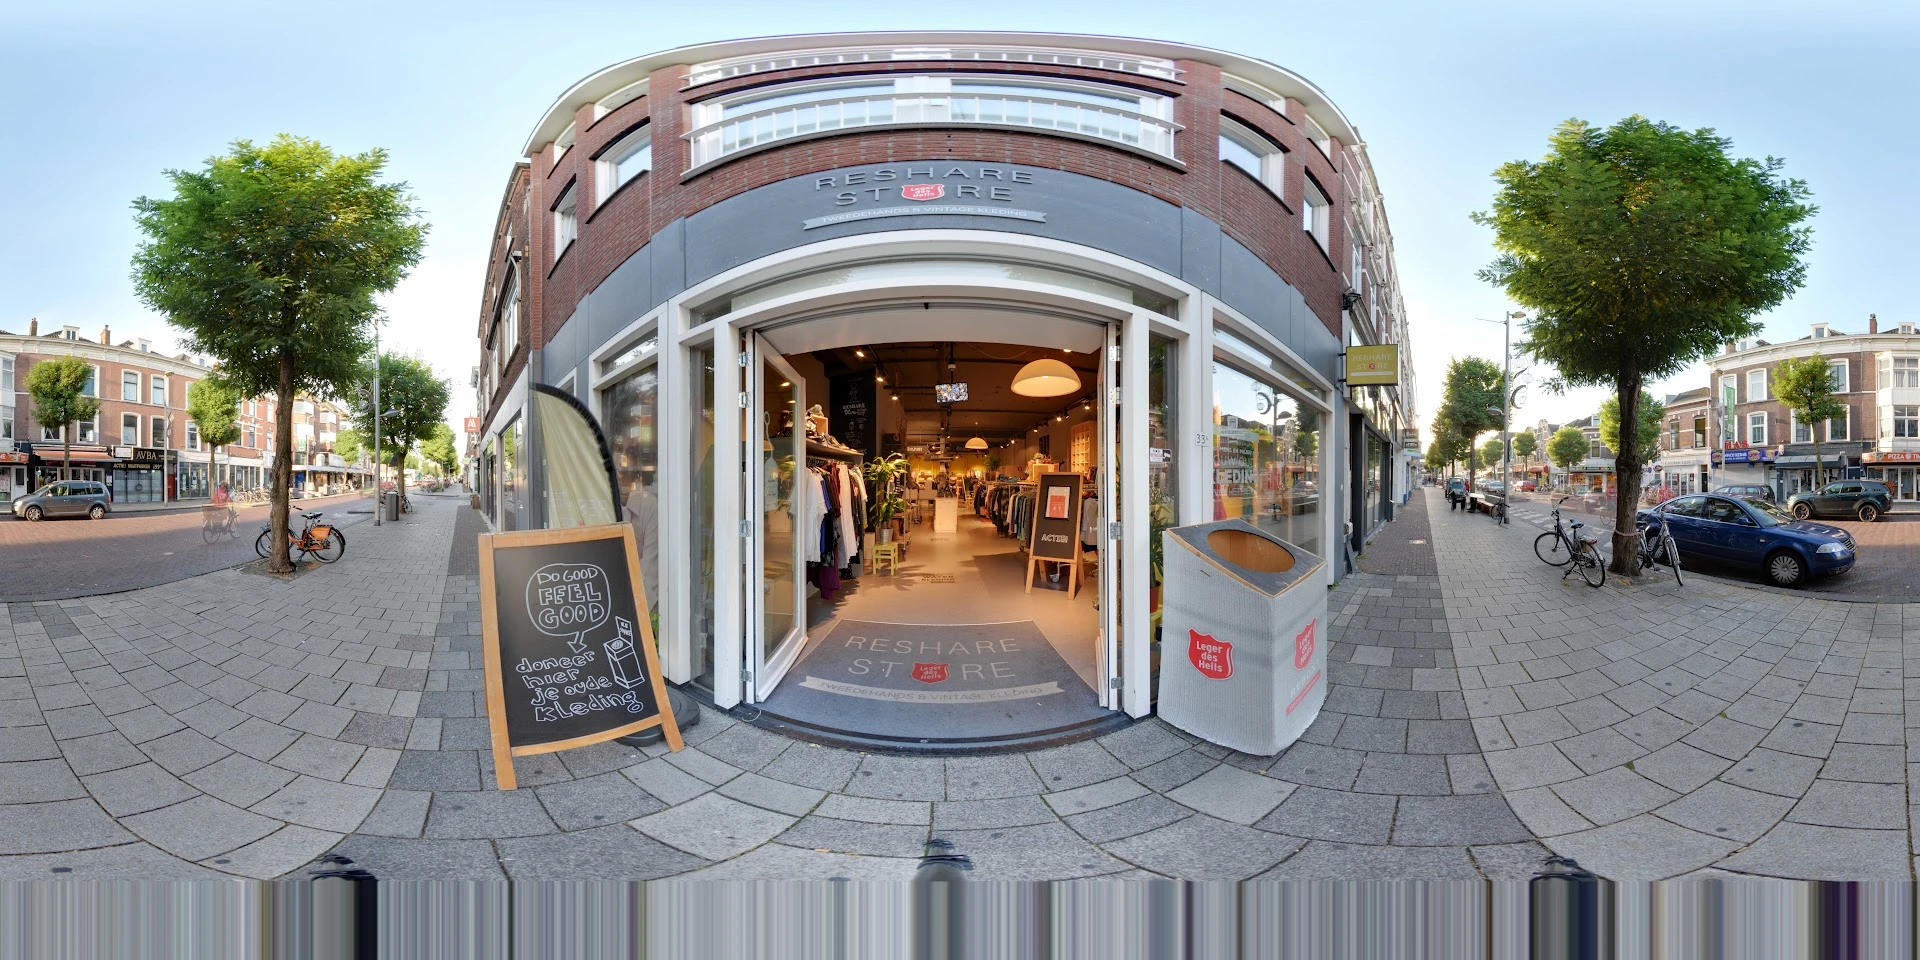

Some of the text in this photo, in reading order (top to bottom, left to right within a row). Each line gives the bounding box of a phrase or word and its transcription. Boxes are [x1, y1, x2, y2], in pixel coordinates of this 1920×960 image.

[815, 167, 1033, 191] RESHARE
[823, 207, 910, 223] TWEEDEHANDS
[977, 207, 1028, 217] KLEDING
[1352, 353, 1392, 362] RESHARE
[136, 450, 157, 460] AVBA
[537, 567, 598, 585] DO GOOD
[538, 602, 605, 629] GOOD
[844, 635, 1022, 655] RESHARE
[1196, 640, 1223, 653] Leger
[516, 651, 595, 673] doneer
[1201, 651, 1218, 662] des
[1198, 660, 1223, 672] Heils
[522, 668, 579, 688] hier
[531, 676, 612, 706] je oude
[820, 682, 914, 700] TWEEDEHANDS
[930, 692, 985, 700] VINTAGE
[989, 687, 1043, 698] KLEDING
